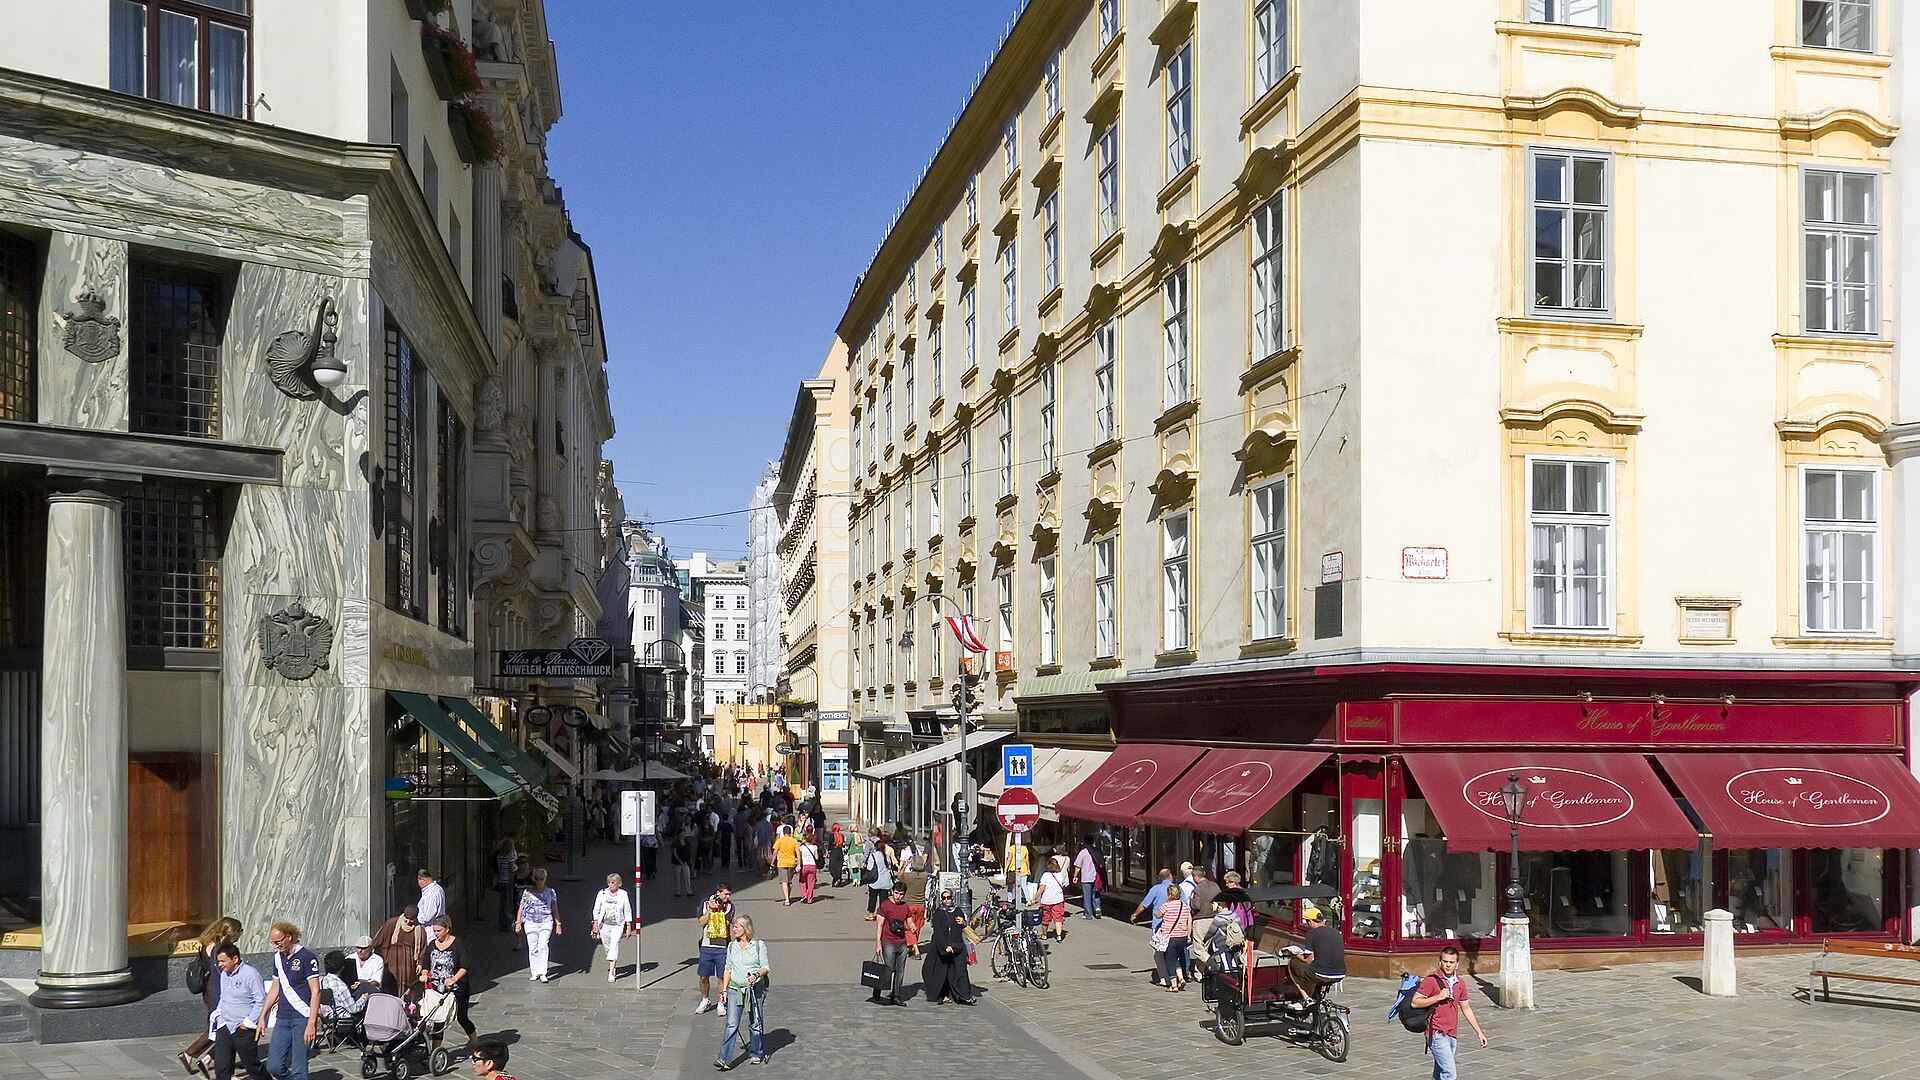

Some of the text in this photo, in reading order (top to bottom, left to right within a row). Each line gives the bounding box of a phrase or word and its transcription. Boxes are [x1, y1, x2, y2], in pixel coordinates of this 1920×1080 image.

[503, 651, 530, 665] Kiss
[532, 655, 541, 664] &
[503, 665, 611, 676] JUWELEN ANTIKSCHMUCK
[1577, 707, 1726, 736] House of Gentlemen
[1526, 796, 1539, 808] of
[1540, 790, 1622, 809] Gentlemen
[1741, 789, 1879, 809] House of Gentlemen
